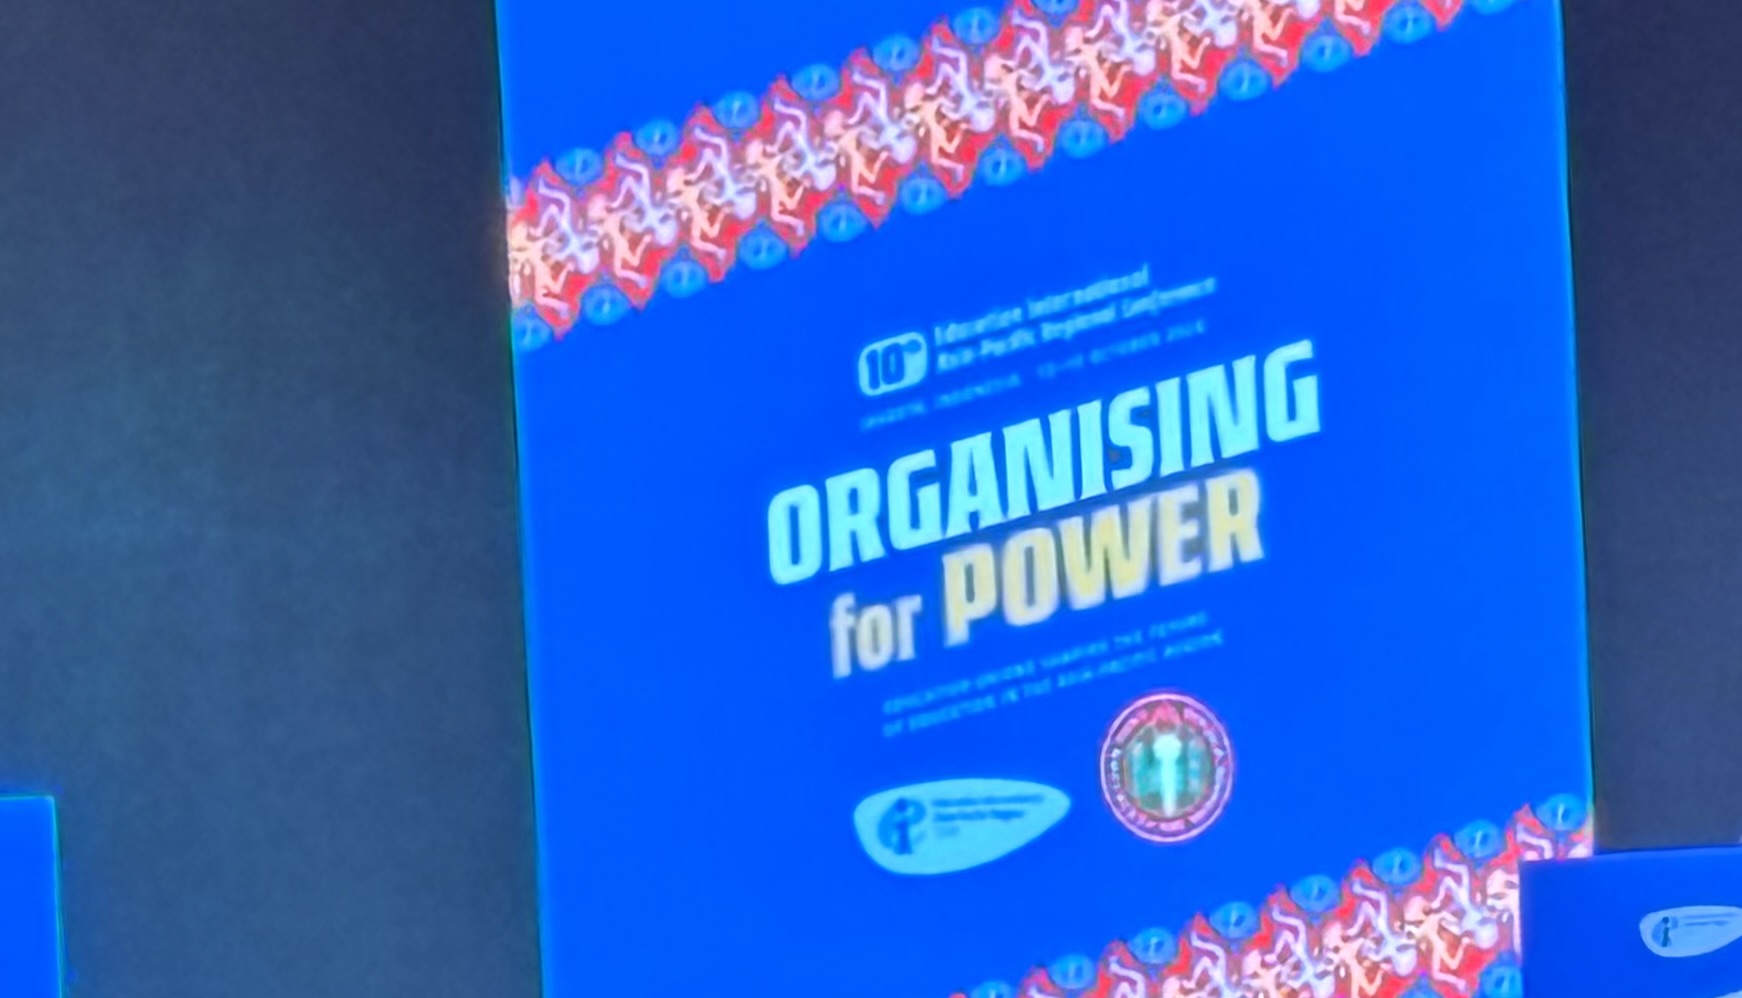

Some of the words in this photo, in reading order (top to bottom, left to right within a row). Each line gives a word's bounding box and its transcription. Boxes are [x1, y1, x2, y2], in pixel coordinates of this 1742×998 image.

[767, 338, 1321, 585] ORGANISING
[829, 592, 922, 679] for
[942, 467, 1264, 648] POWER
